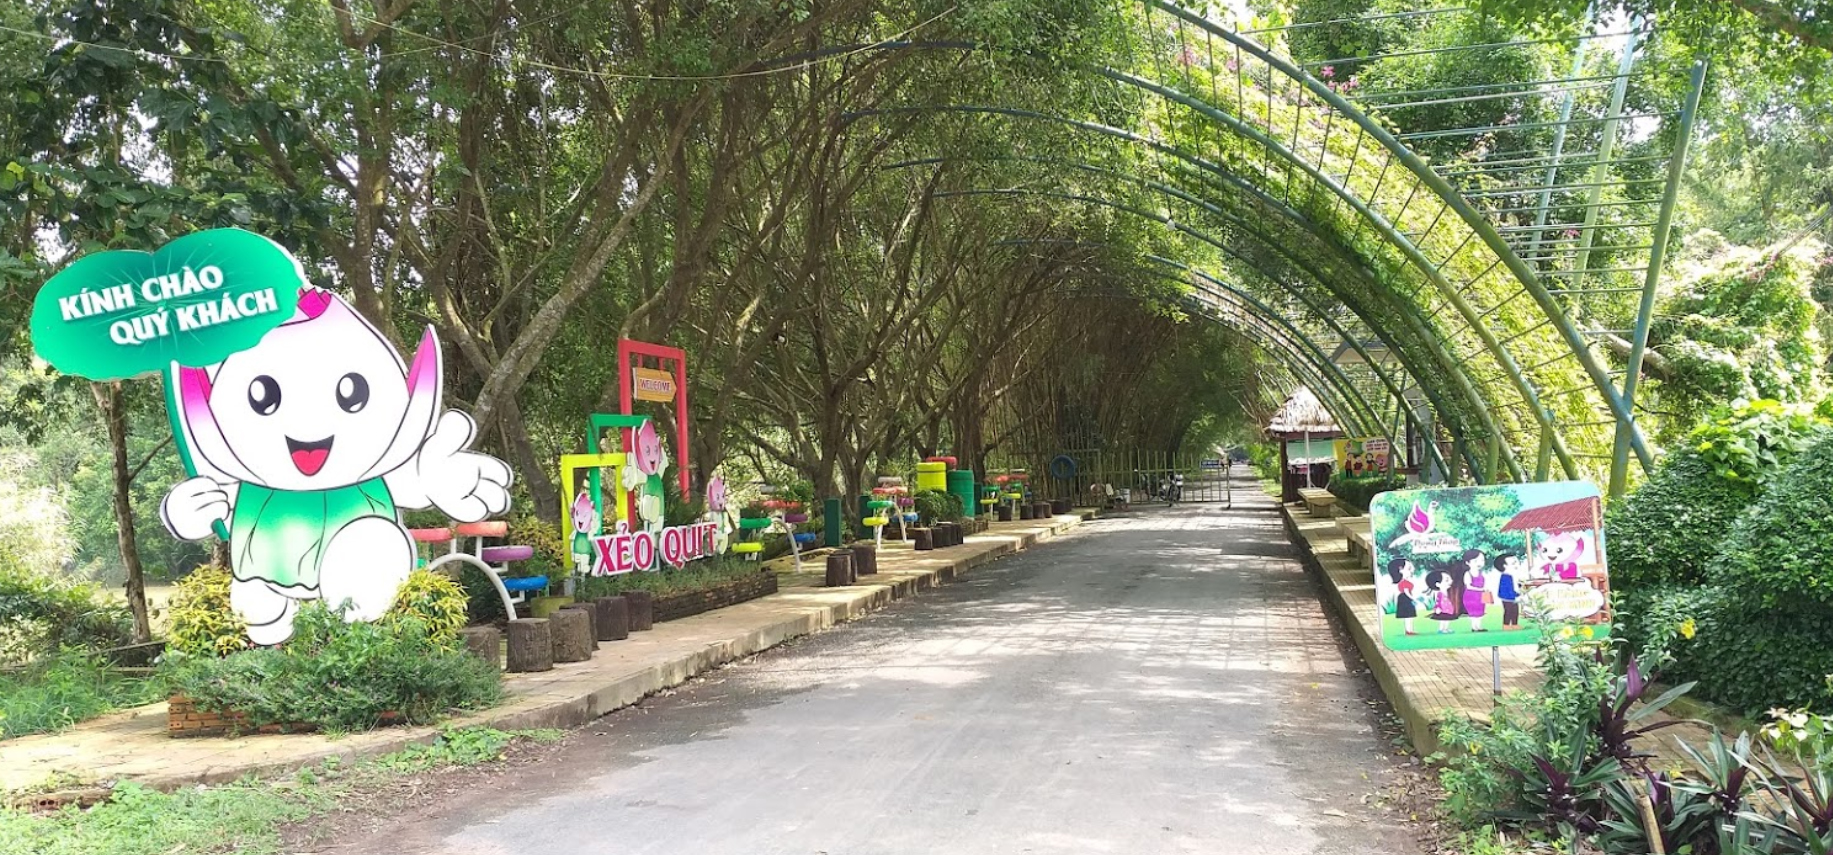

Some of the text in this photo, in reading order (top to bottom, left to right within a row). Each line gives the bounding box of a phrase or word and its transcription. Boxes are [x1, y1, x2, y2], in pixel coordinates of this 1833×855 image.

[58, 265, 223, 321] KÍNH CHÀO
[109, 287, 278, 345] QUÝ KHÁCH
[639, 379, 671, 392] WELCOME
[596, 522, 654, 575] XẺO
